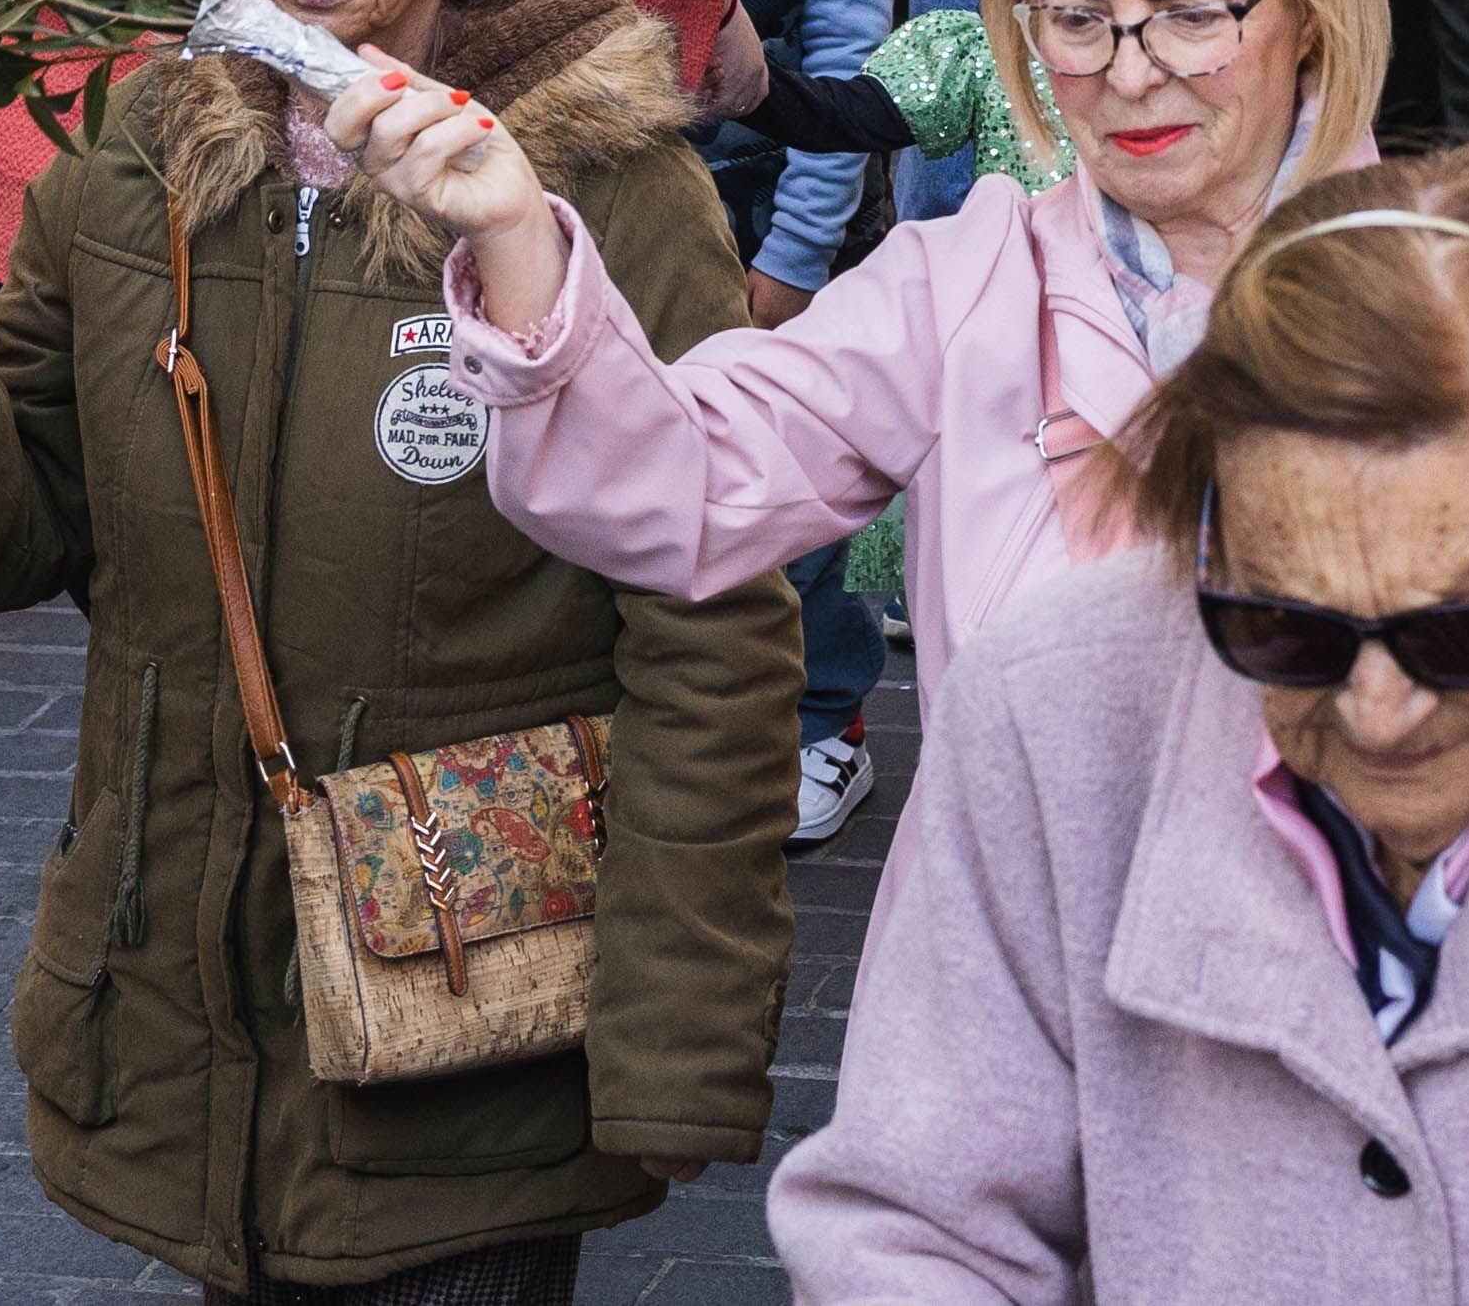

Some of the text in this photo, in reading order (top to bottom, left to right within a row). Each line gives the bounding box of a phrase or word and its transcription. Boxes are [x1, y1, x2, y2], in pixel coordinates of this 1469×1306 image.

[388, 429, 479, 447] MAD FOR FAME
[397, 445, 464, 470] Down
